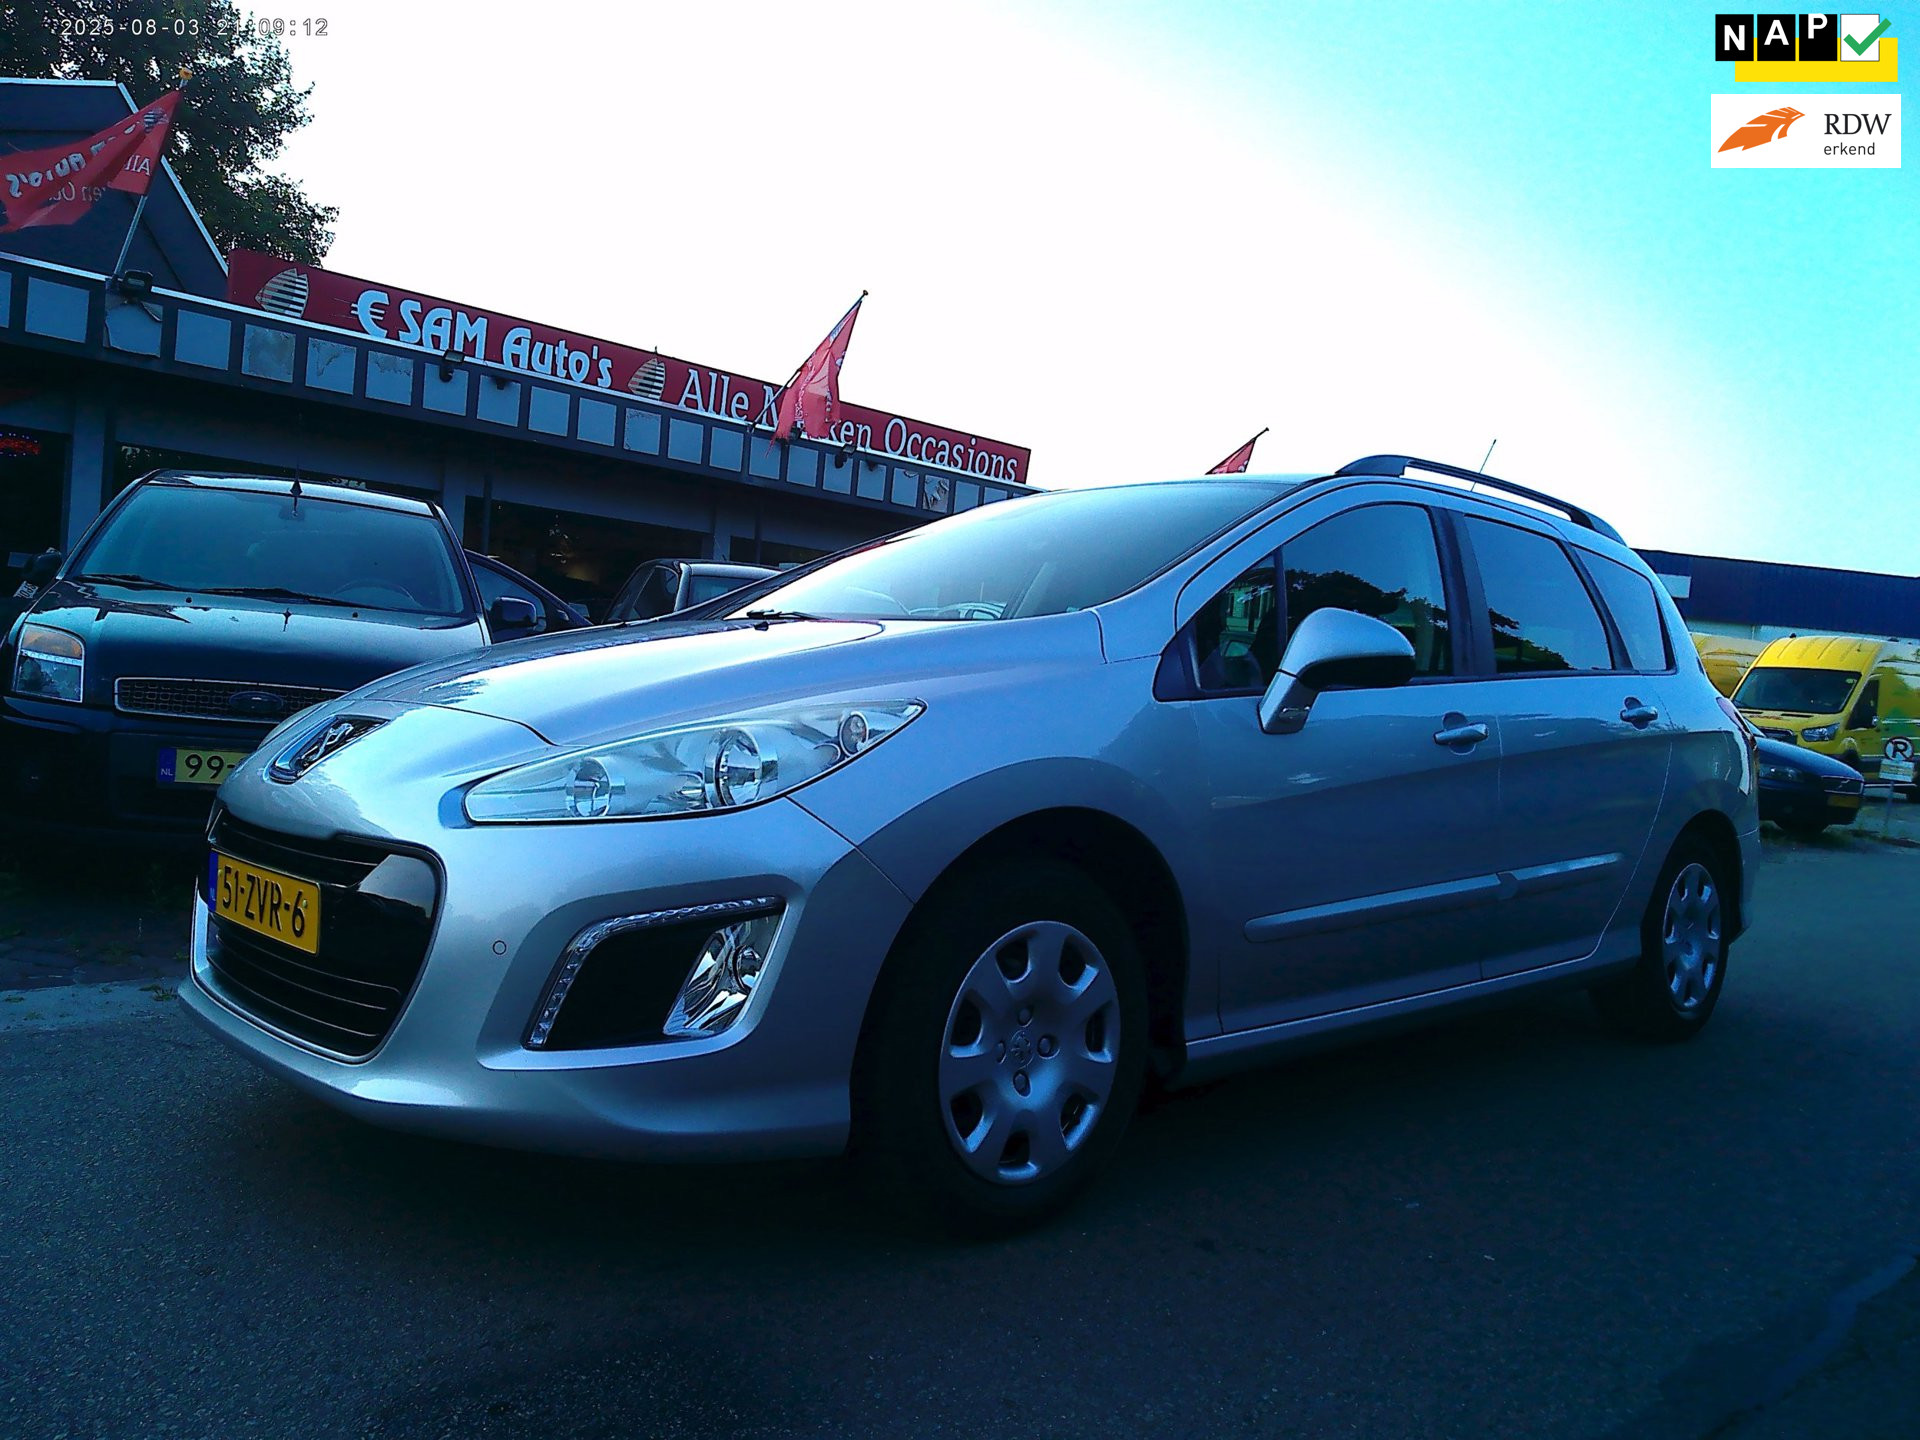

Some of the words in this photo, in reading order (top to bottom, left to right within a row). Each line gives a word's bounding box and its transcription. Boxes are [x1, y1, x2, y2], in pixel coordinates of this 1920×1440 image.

[397, 299, 489, 360] SAM
[502, 327, 613, 389] Auto's
[678, 368, 750, 423] Alle
[760, 385, 873, 452] Mken
[884, 417, 1018, 483] Occasions
[160, 768, 173, 776] NL
[222, 864, 307, 938] 51-ZVR-6
